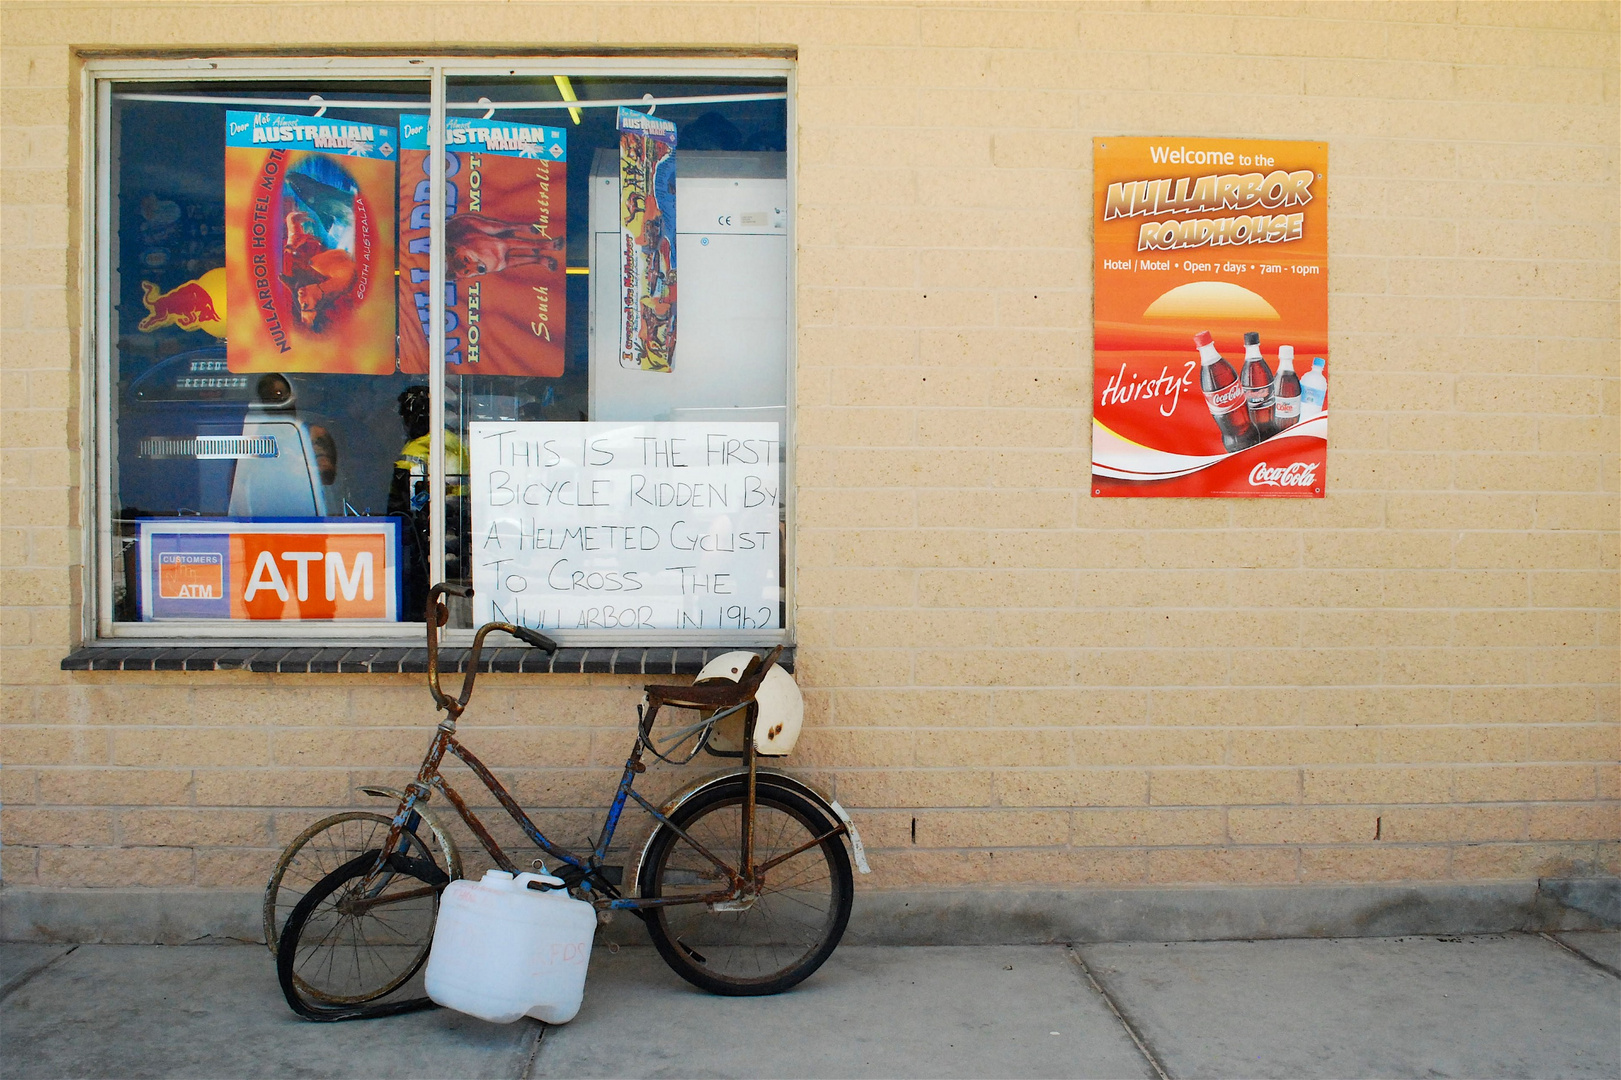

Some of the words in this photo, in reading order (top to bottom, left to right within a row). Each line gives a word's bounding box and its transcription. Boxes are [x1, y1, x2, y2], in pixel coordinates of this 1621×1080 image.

[230, 122, 249, 136] Door
[254, 113, 270, 128] Mat
[253, 126, 374, 144] AUSTRALIAN
[404, 124, 424, 138] Door
[427, 128, 544, 146] USTRALIAN
[622, 118, 674, 132] AUSTRALIAN
[1150, 146, 1234, 165] Welcome
[1239, 154, 1252, 166] to
[1255, 154, 1274, 167] the
[469, 152, 482, 212] MOT
[534, 158, 552, 240] Australia
[1104, 170, 1314, 222] NULLARBOR
[251, 192, 270, 249] HOTEL
[356, 198, 372, 261] AUSTRALIA
[1138, 212, 1304, 252] ROADHOUSE
[356, 264, 370, 300] SOUTH
[1104, 259, 1132, 270] Hotel
[1140, 260, 1170, 270] Motel
[1184, 260, 1212, 274] Open
[1214, 262, 1220, 274] 7
[1222, 261, 1246, 275] days
[1260, 264, 1282, 275] 7am
[1290, 264, 1320, 277] 10pm
[257, 253, 291, 354] NULLARBOR
[530, 286, 550, 342] South
[467, 281, 481, 363] HOTEL
[624, 306, 634, 350] crossed
[190, 362, 222, 371] NEED
[622, 352, 634, 361] I
[1101, 360, 1196, 417] thirsty?
[483, 430, 561, 468] THIS
[583, 438, 614, 467] IS
[634, 436, 689, 468] THE
[706, 434, 780, 466] FIRST
[488, 470, 610, 507] BICYCLE
[630, 474, 728, 508] RIDDEN
[1248, 462, 1320, 488] Coca-Cola
[483, 520, 502, 550] A
[519, 516, 660, 551] HELMETED
[670, 520, 772, 552] CYCLIST
[163, 556, 218, 564] CUSTOMERS
[244, 550, 374, 602] ATM
[482, 558, 528, 593] TO
[548, 558, 644, 592] CROSS
[666, 566, 732, 595] THE
[178, 584, 212, 598] ATM
[677, 608, 703, 630] IN
